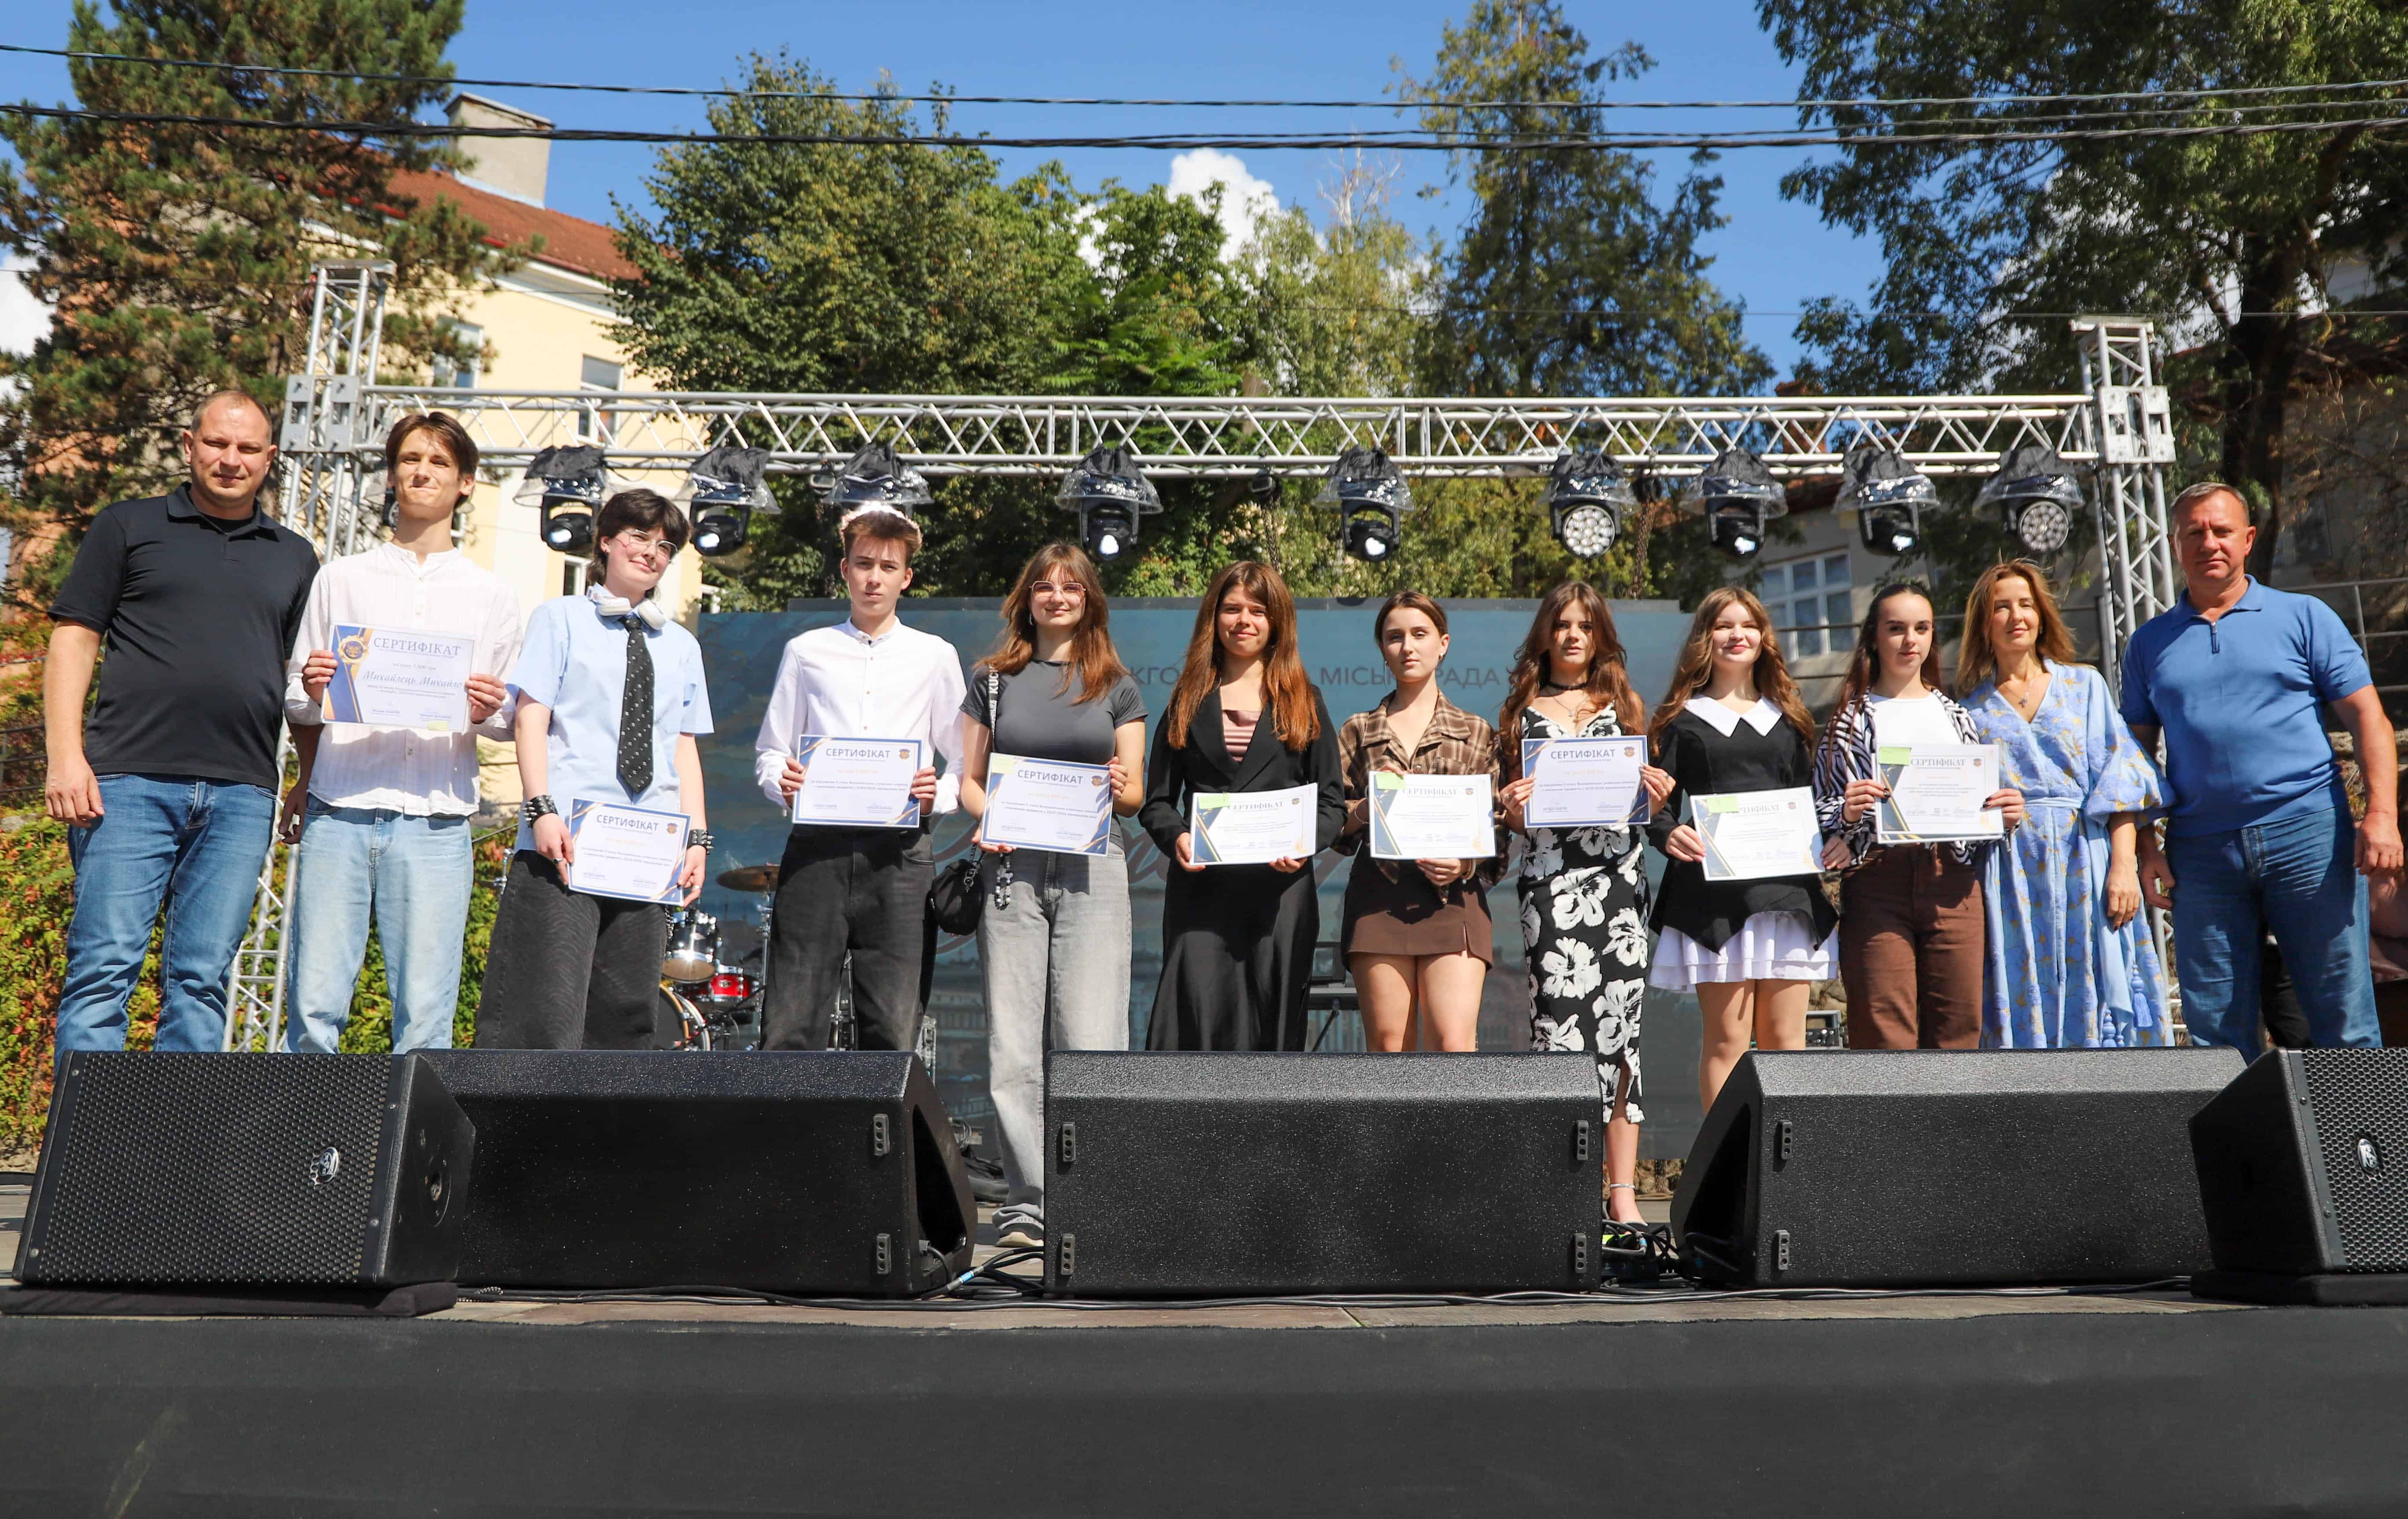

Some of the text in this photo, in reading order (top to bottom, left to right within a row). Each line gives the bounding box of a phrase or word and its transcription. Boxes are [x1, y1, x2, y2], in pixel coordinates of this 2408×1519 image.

[373, 637, 461, 656] СЕРТИФІКАТ
[826, 748, 891, 758] СЕРТИФІКАТ
[1551, 749, 1615, 759] СЕРТИФІКАТ
[1017, 769, 1083, 784] СЕРТИФІКАТ
[596, 814, 660, 831] СЕРТИФІКАТ
